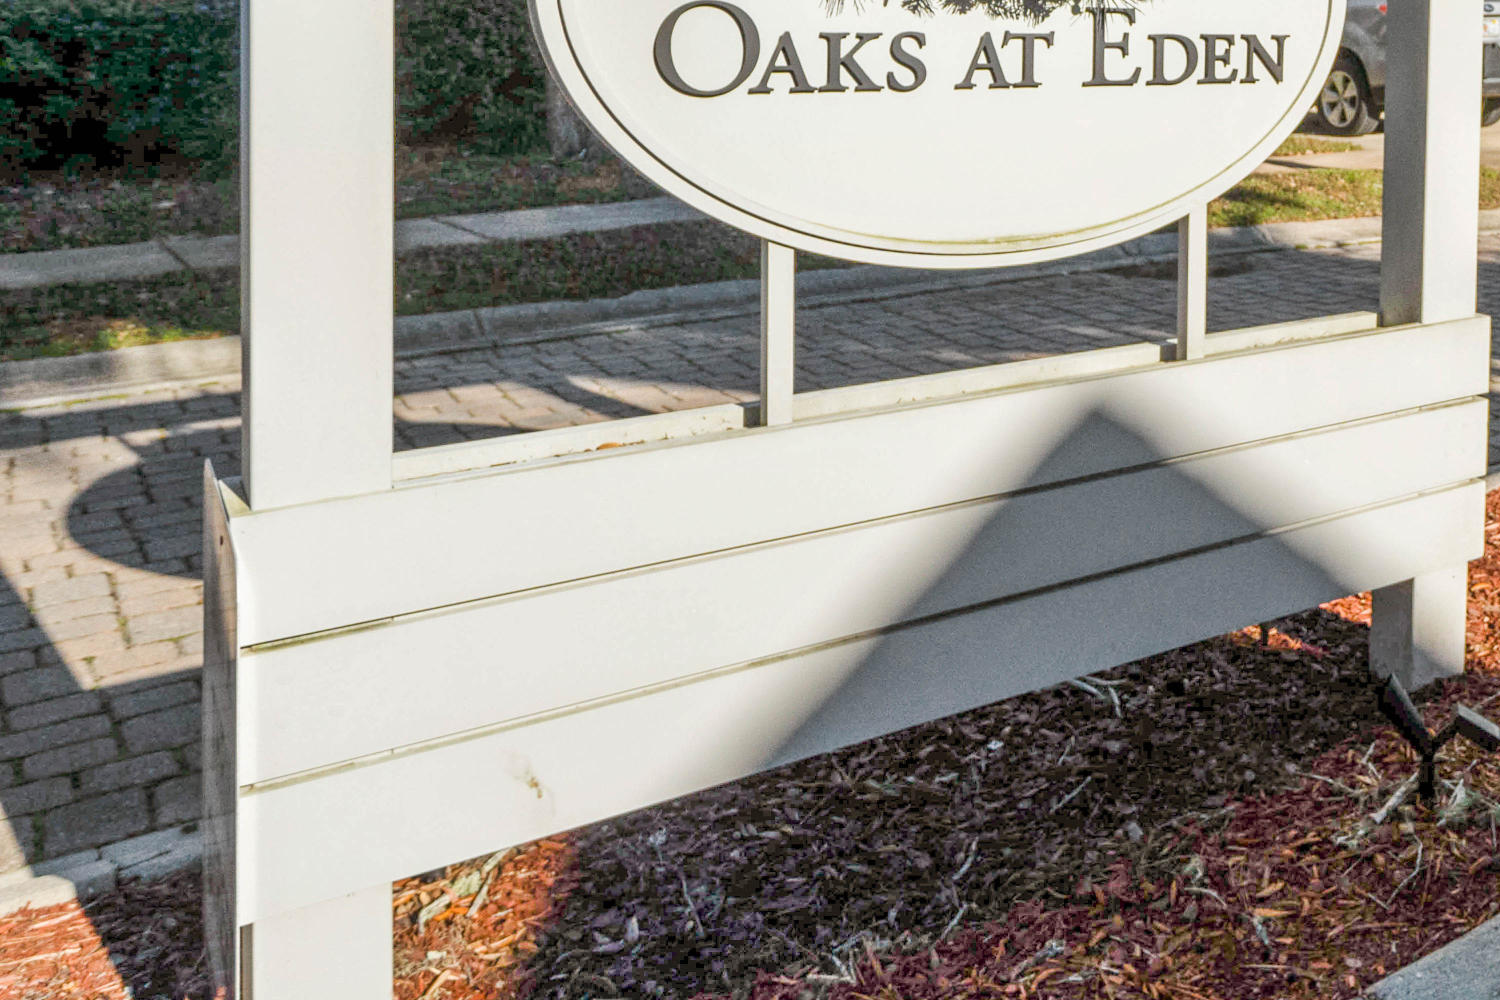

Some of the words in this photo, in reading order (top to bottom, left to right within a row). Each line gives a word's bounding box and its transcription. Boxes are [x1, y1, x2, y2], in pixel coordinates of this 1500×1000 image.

[653, 0, 927, 98] OAKS
[954, 31, 1055, 90] AT
[1082, 6, 1291, 87] EDEN
